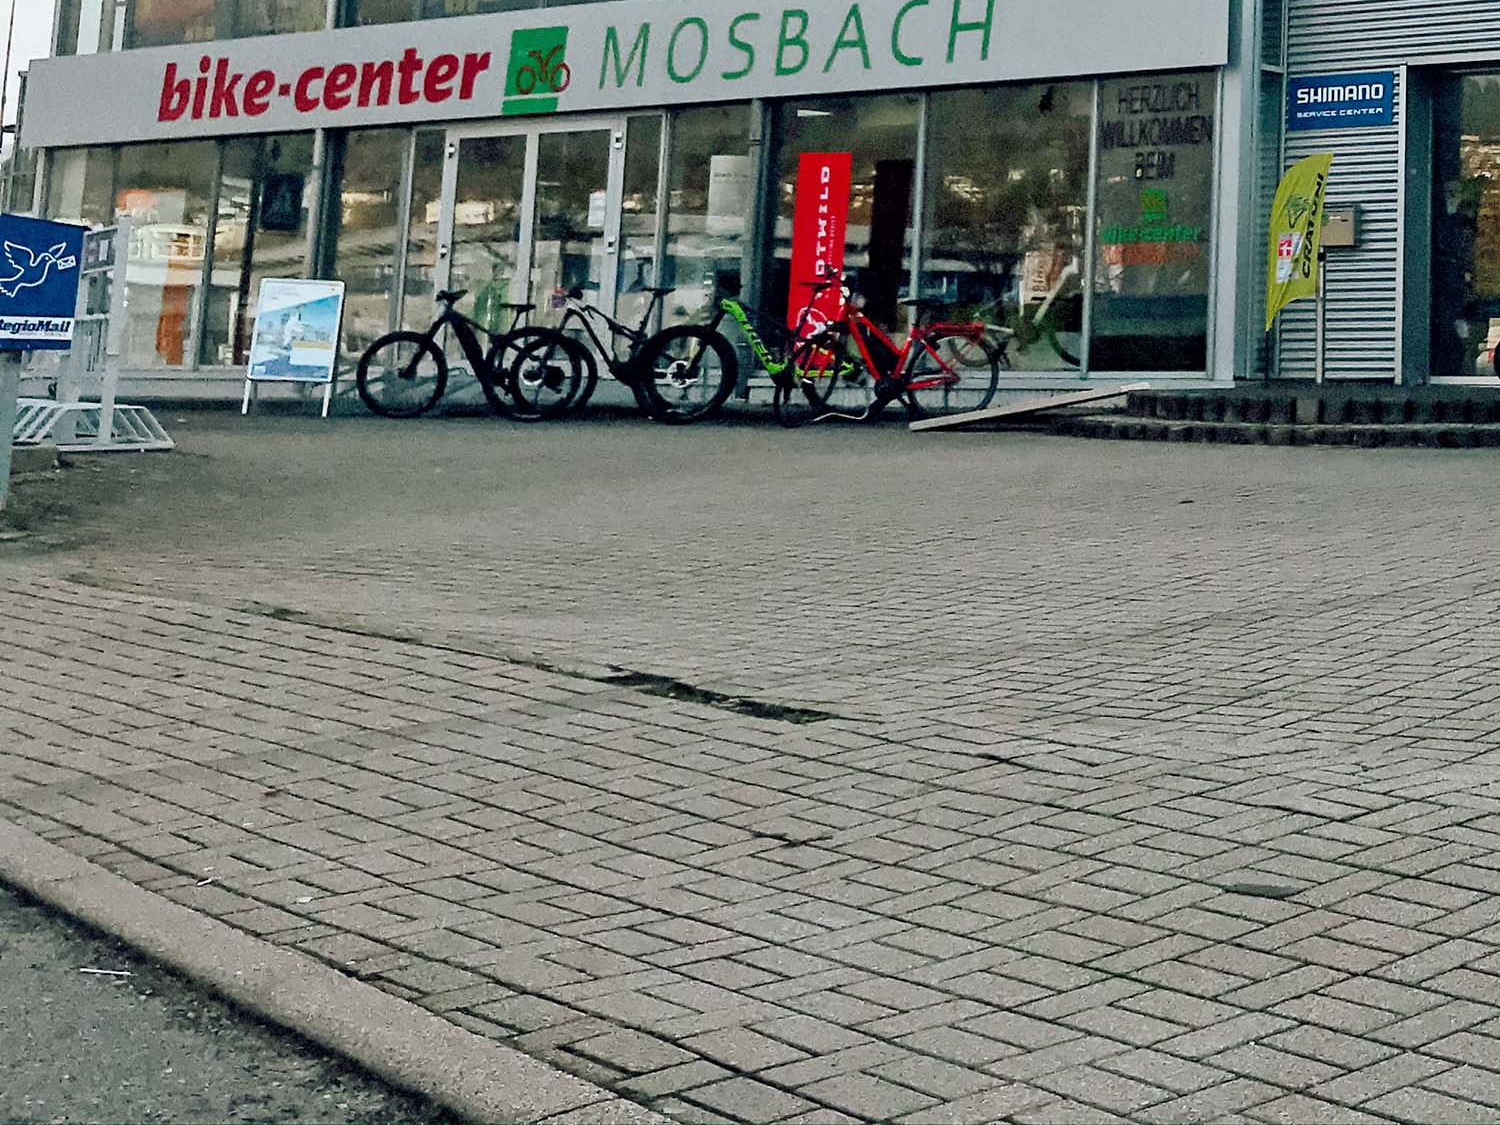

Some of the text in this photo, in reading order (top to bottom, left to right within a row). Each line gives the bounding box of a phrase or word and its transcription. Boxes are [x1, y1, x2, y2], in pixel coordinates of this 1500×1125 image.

[158, 47, 491, 122] bike-center
[1118, 81, 1199, 114] HERZLICH
[1297, 84, 1384, 104] SHIMANO
[1297, 108, 1383, 118] SERVICE CENTER
[1101, 115, 1213, 148] WILLKOMMEN
[813, 166, 830, 289] OTWILD
